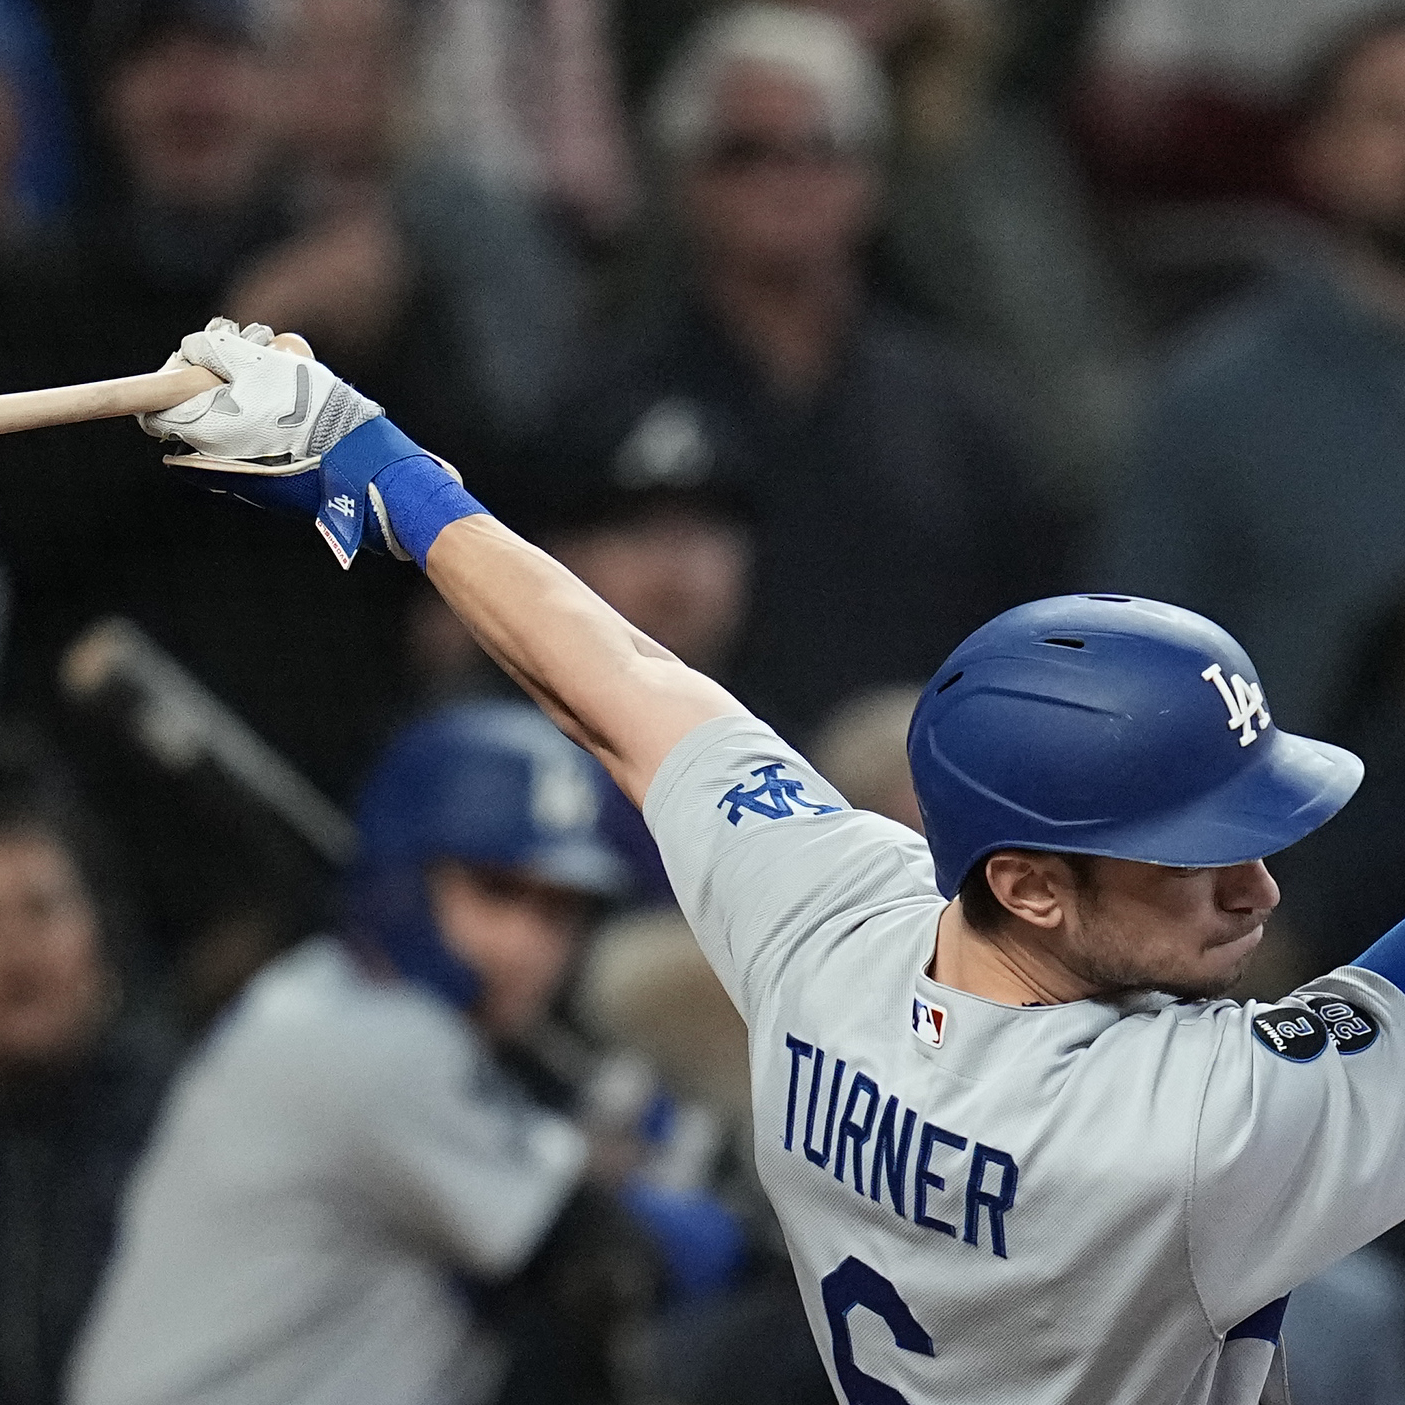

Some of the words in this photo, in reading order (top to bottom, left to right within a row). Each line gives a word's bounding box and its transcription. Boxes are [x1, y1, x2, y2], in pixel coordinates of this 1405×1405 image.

[328, 494, 355, 518] LA
[317, 520, 348, 565] EVOSHIELD
[1201, 663, 1272, 747] LA
[1256, 1019, 1288, 1052] TOMMY
[1276, 1016, 1315, 1039] 2
[1320, 1002, 1372, 1040] 20
[784, 1032, 1019, 1259] TURNER
